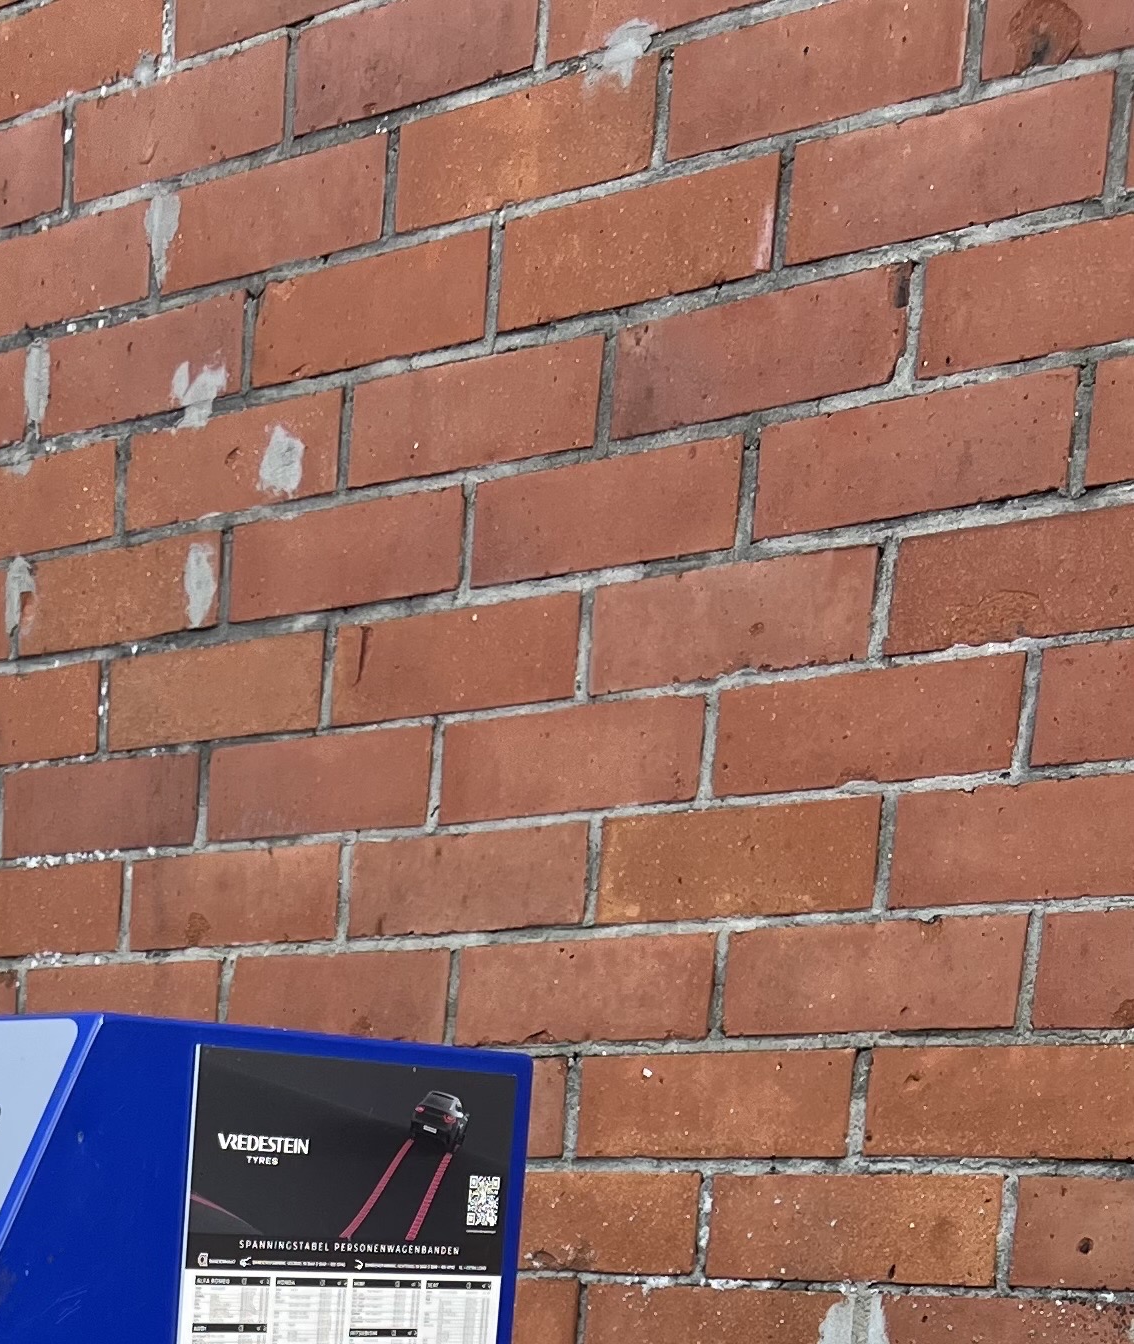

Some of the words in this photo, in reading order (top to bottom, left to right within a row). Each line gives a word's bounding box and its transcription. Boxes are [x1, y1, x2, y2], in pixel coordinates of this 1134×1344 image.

[217, 1132, 310, 1155] VREDESTEIN
[246, 1155, 279, 1166] TYRES
[238, 1239, 330, 1252] SPANNINGSTABEL
[334, 1242, 460, 1256] PERSONENWAGENBANDEN
